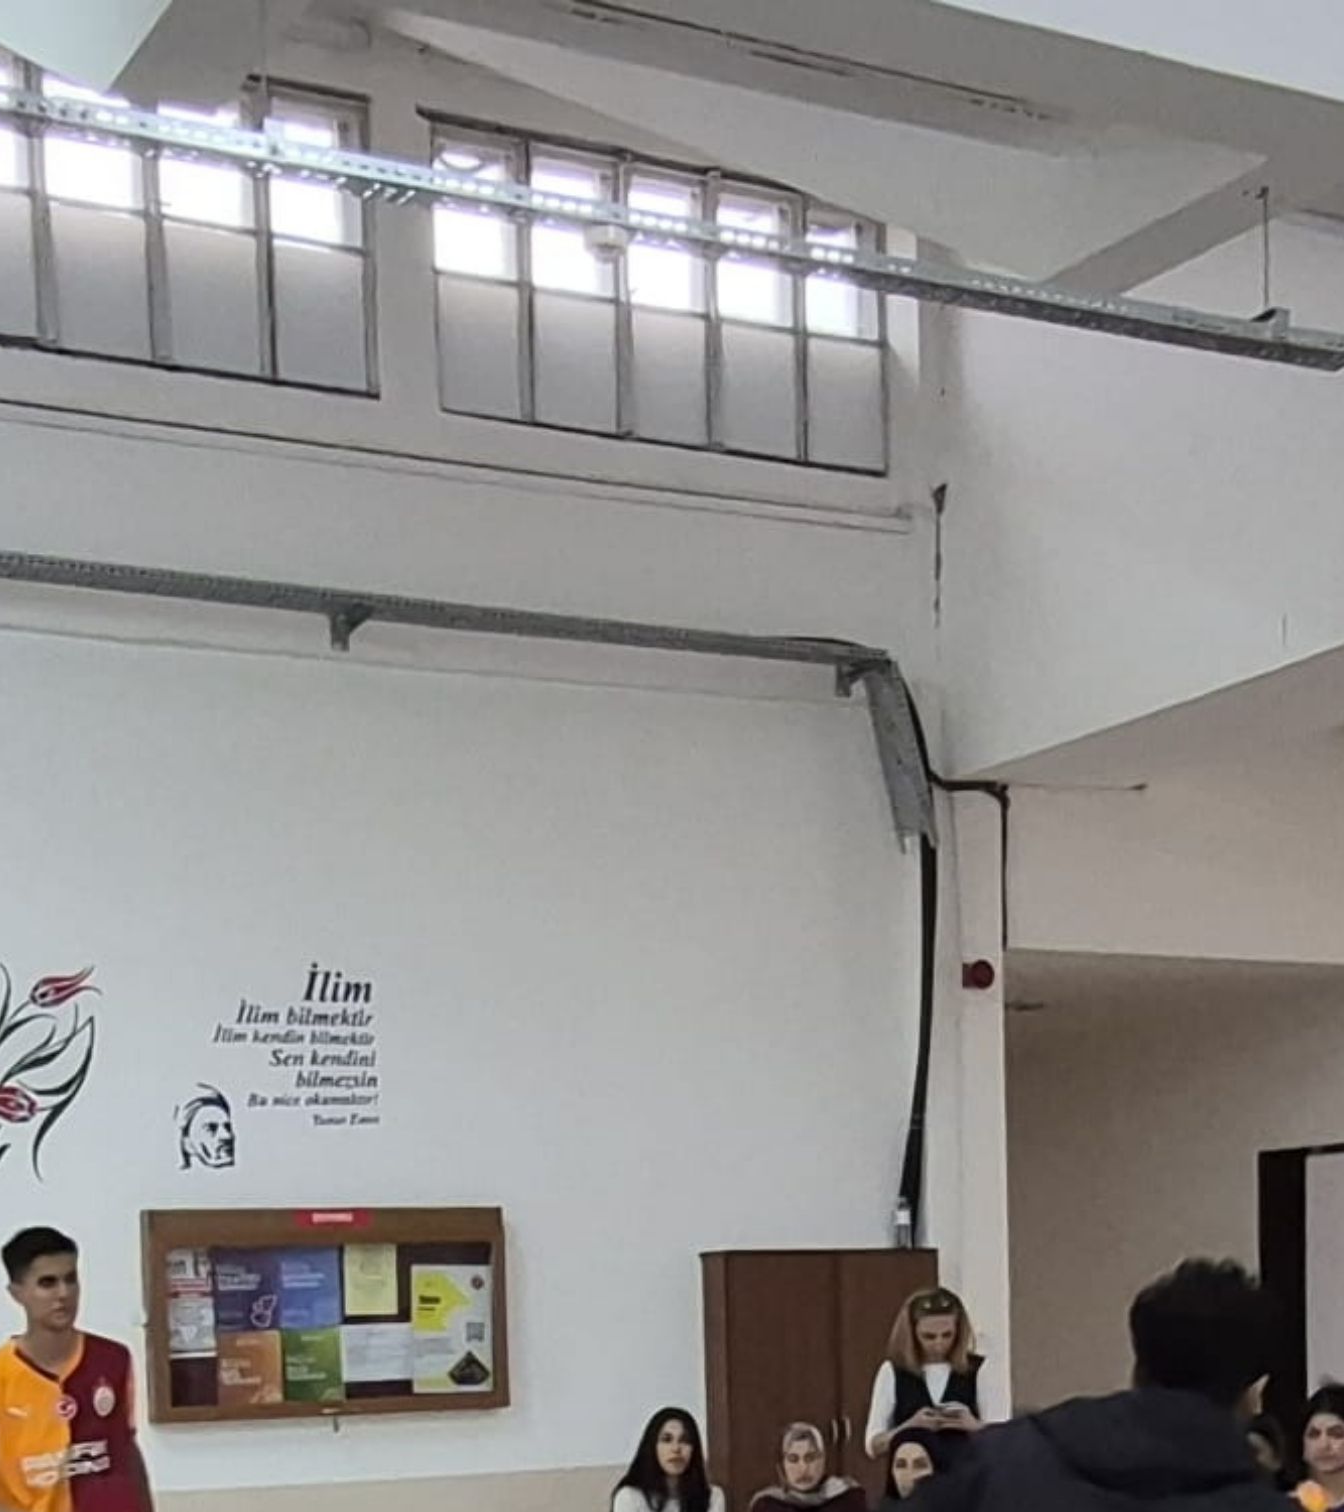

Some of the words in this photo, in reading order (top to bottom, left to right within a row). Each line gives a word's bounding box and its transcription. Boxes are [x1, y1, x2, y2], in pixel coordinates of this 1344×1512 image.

[303, 962, 372, 1003] İlim
[286, 1006, 373, 1027] bilmektir
[269, 1048, 304, 1067] Sen
[310, 1049, 376, 1067] kendini
